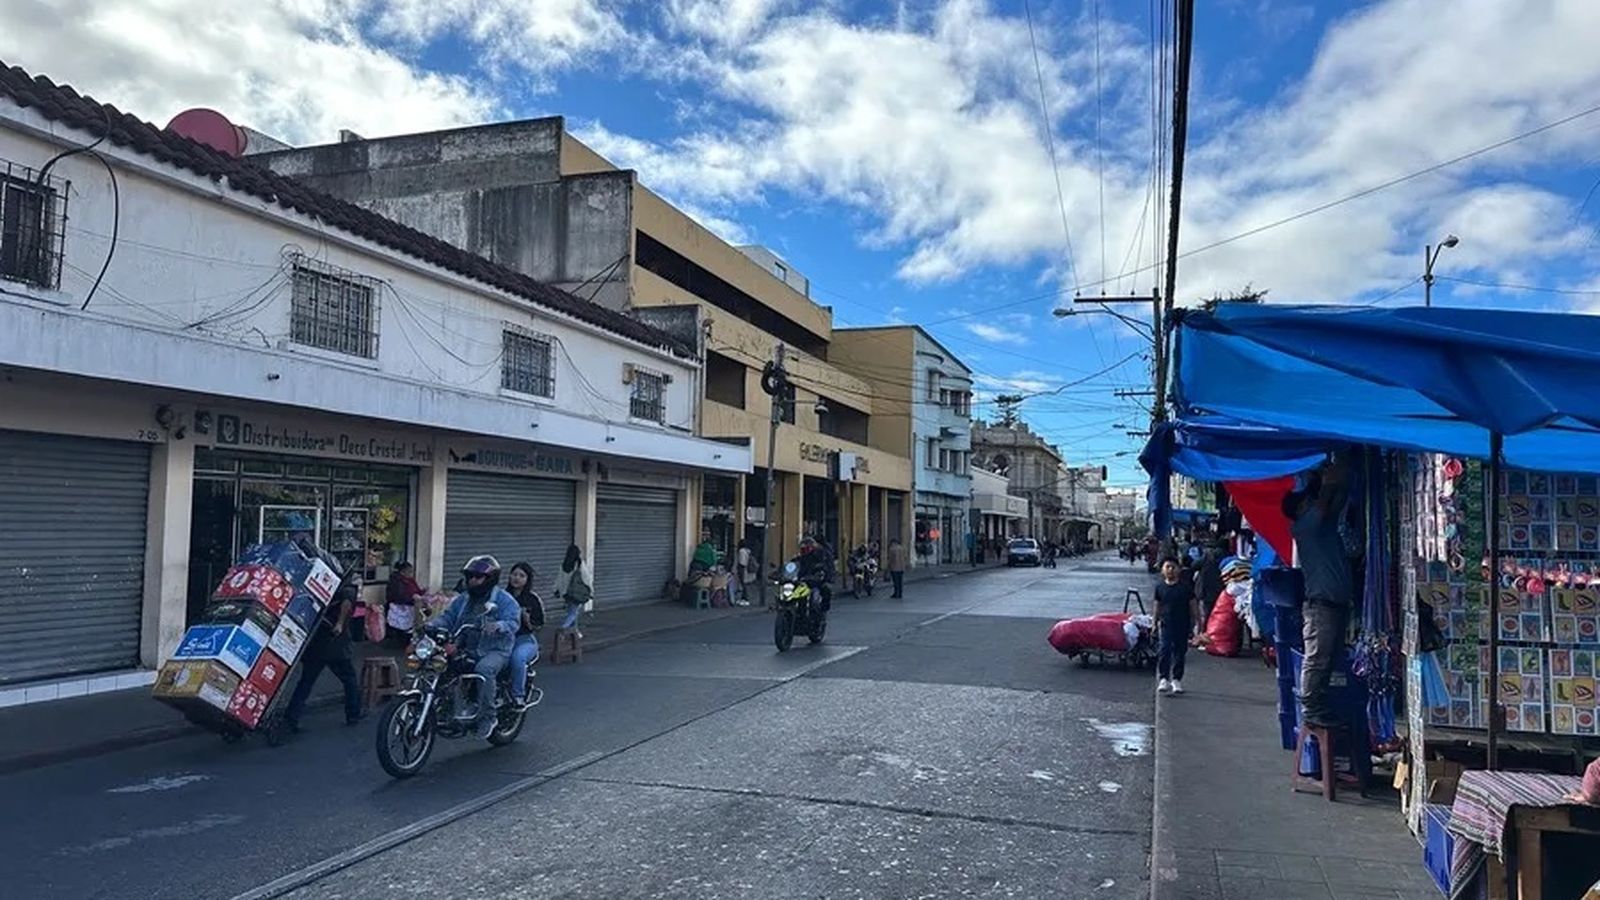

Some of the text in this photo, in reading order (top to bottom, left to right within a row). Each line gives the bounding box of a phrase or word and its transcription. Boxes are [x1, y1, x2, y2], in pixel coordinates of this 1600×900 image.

[243, 422, 325, 451] Distribuidora
[339, 433, 366, 456] Deco
[369, 437, 406, 459] Cristal
[477, 448, 529, 470] BOUTIQUE
